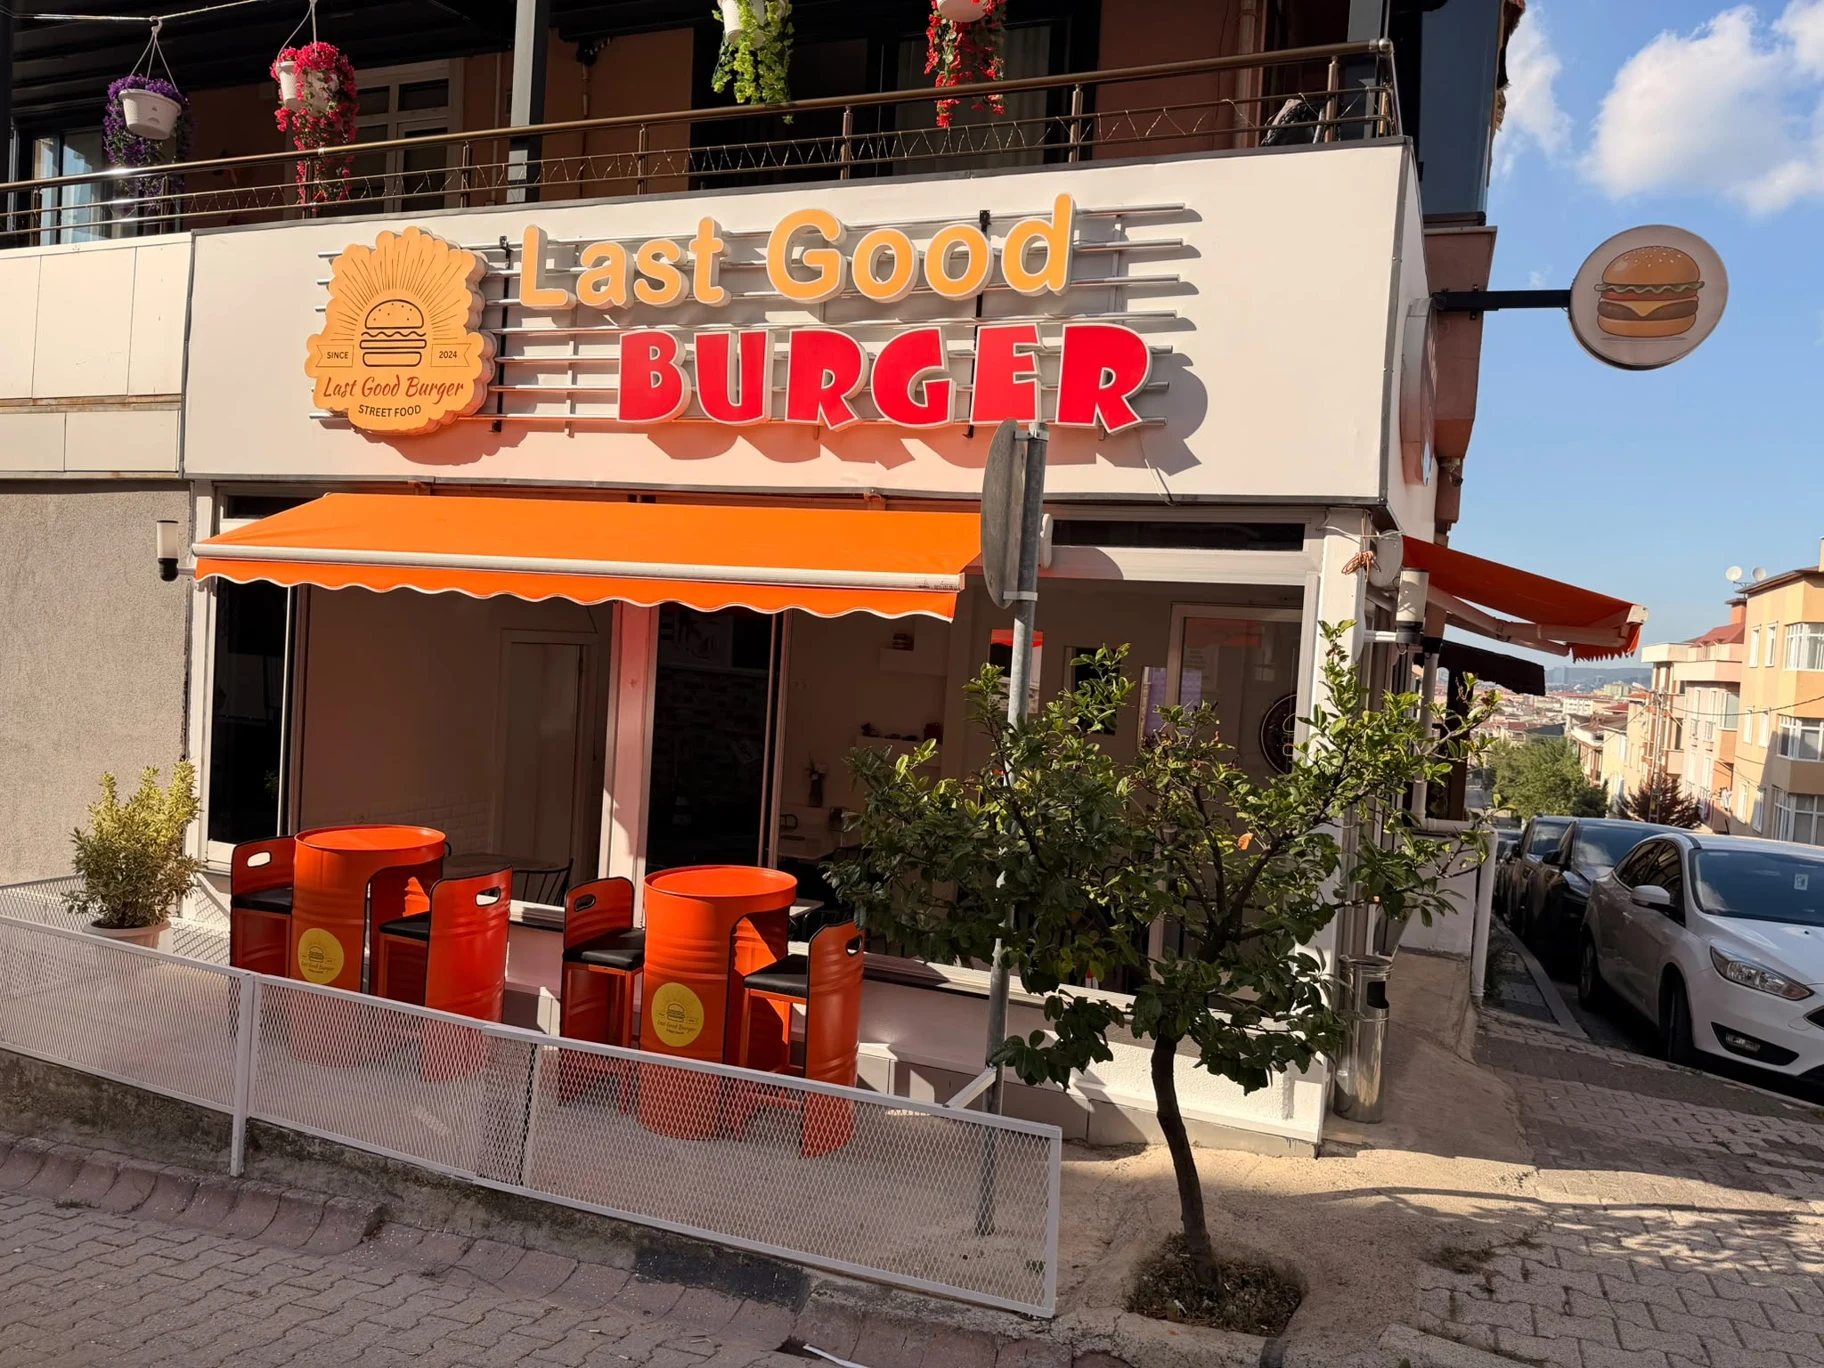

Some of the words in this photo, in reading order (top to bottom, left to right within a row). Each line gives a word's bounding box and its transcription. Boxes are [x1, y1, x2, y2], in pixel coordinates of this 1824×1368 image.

[519, 215, 731, 310] Last
[766, 192, 1077, 304] Good
[326, 351, 349, 360] SINCE
[438, 350, 458, 359] 2024
[616, 322, 1154, 434] BURGER
[323, 376, 358, 398] Last
[361, 374, 401, 398] Good
[405, 376, 464, 405] Burger
[358, 404, 392, 418] STREET
[394, 404, 422, 417] FOOD
